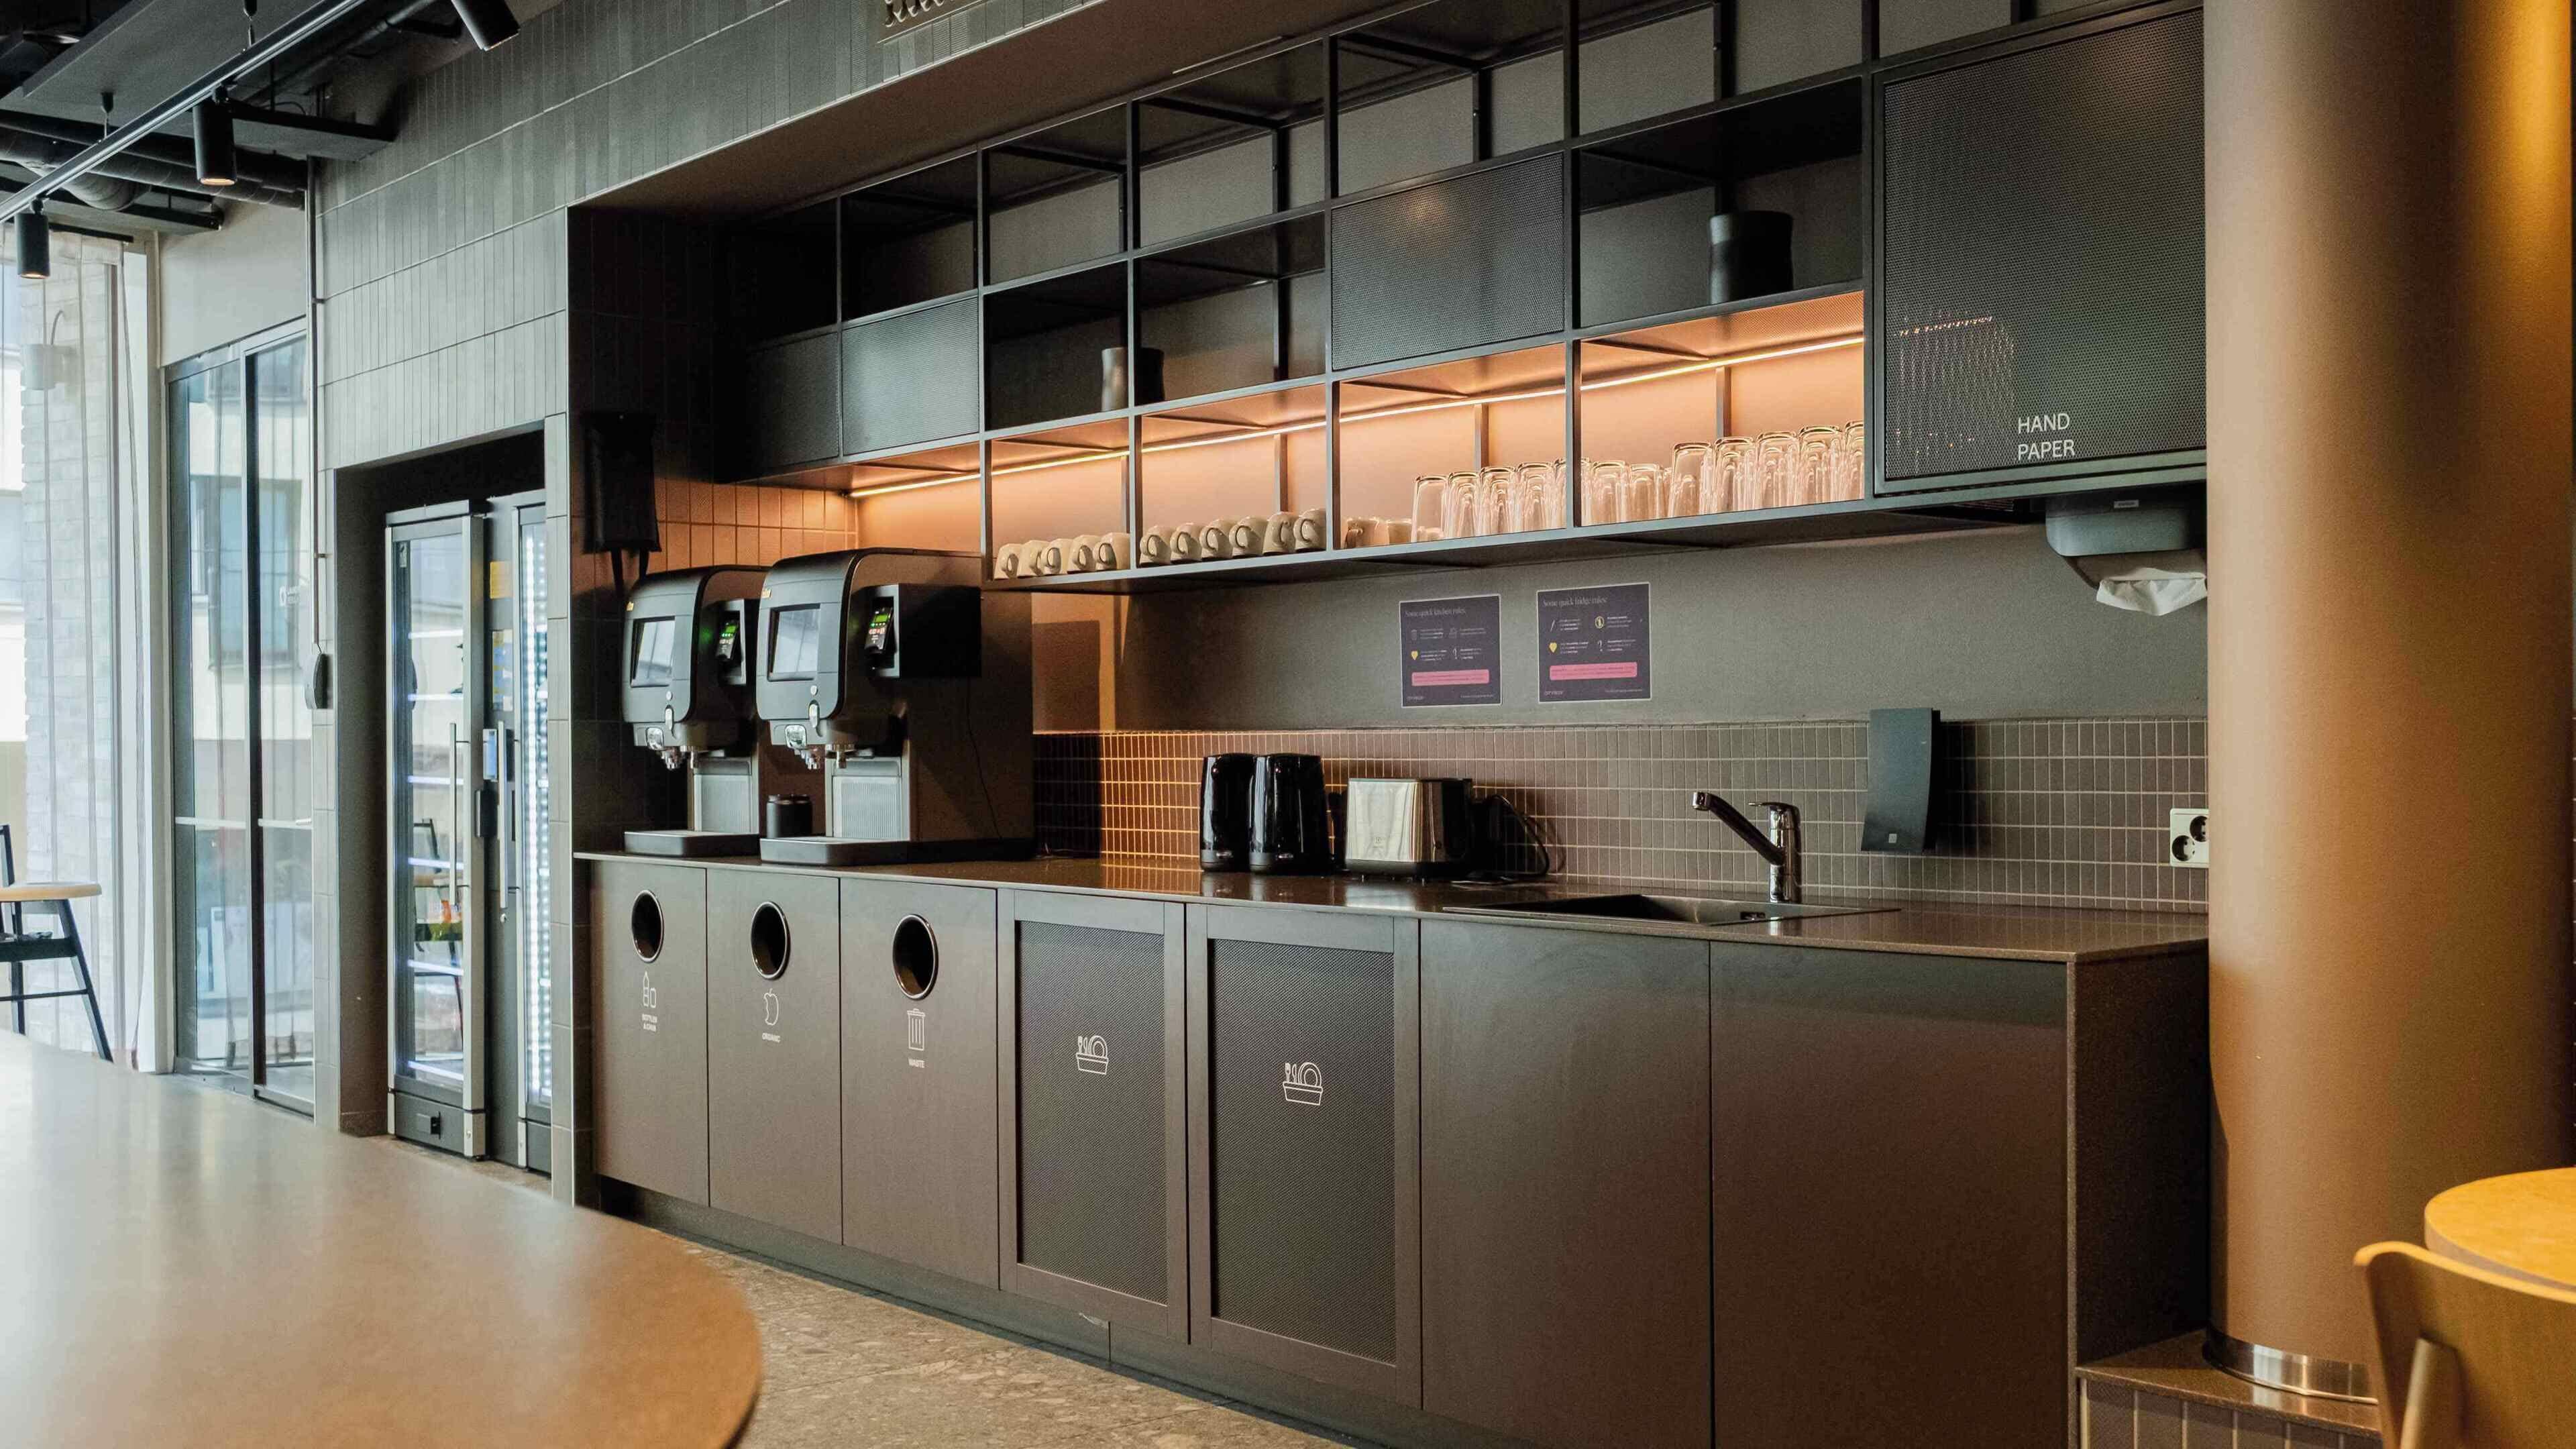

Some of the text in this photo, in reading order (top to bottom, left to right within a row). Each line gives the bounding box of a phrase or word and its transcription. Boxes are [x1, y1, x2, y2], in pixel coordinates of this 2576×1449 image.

[2018, 413, 2070, 434] HAND
[2018, 439, 2075, 461] PAPER
[908, 1057, 925, 1068] WASTE
